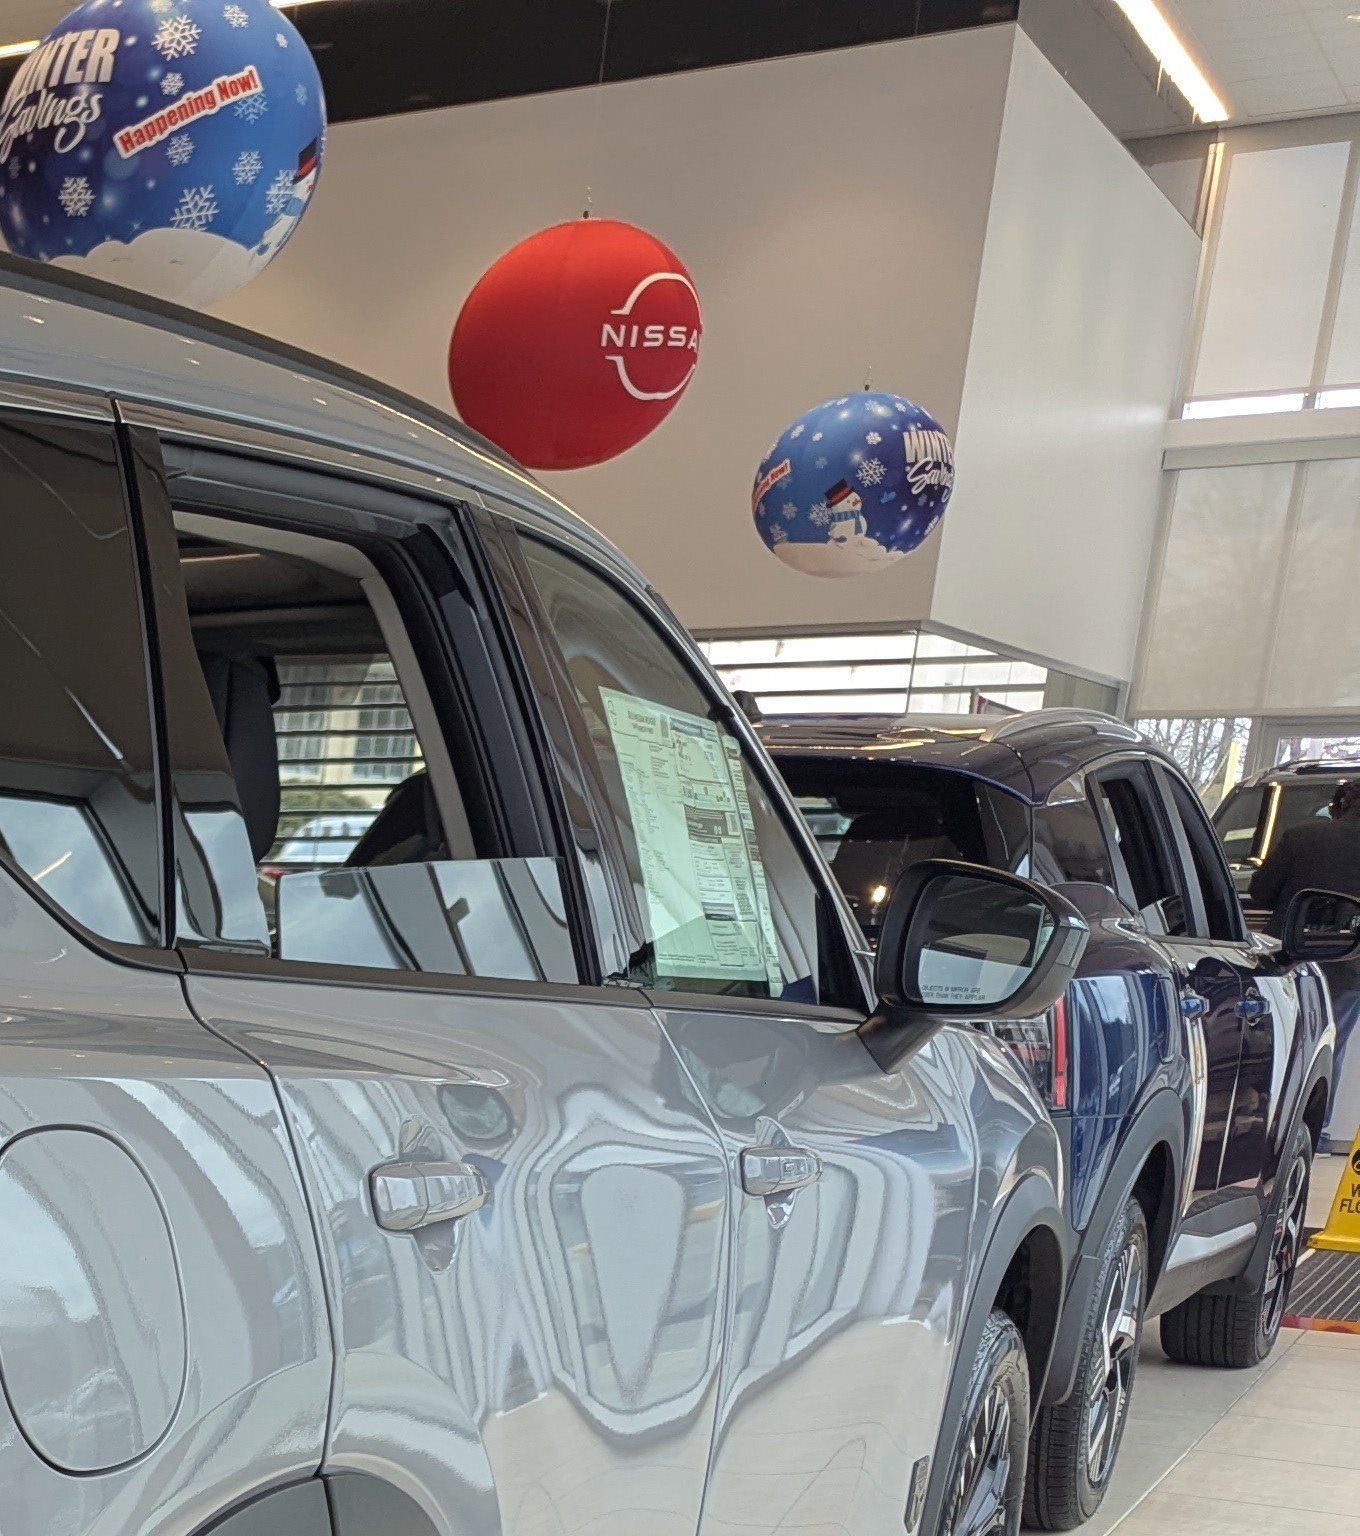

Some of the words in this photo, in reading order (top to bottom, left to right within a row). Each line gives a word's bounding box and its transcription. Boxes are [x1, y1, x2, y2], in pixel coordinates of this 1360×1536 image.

[1, 28, 120, 114] WINTER
[118, 89, 216, 154] Happening
[216, 69, 259, 101] Now!
[601, 323, 699, 354] NISSA
